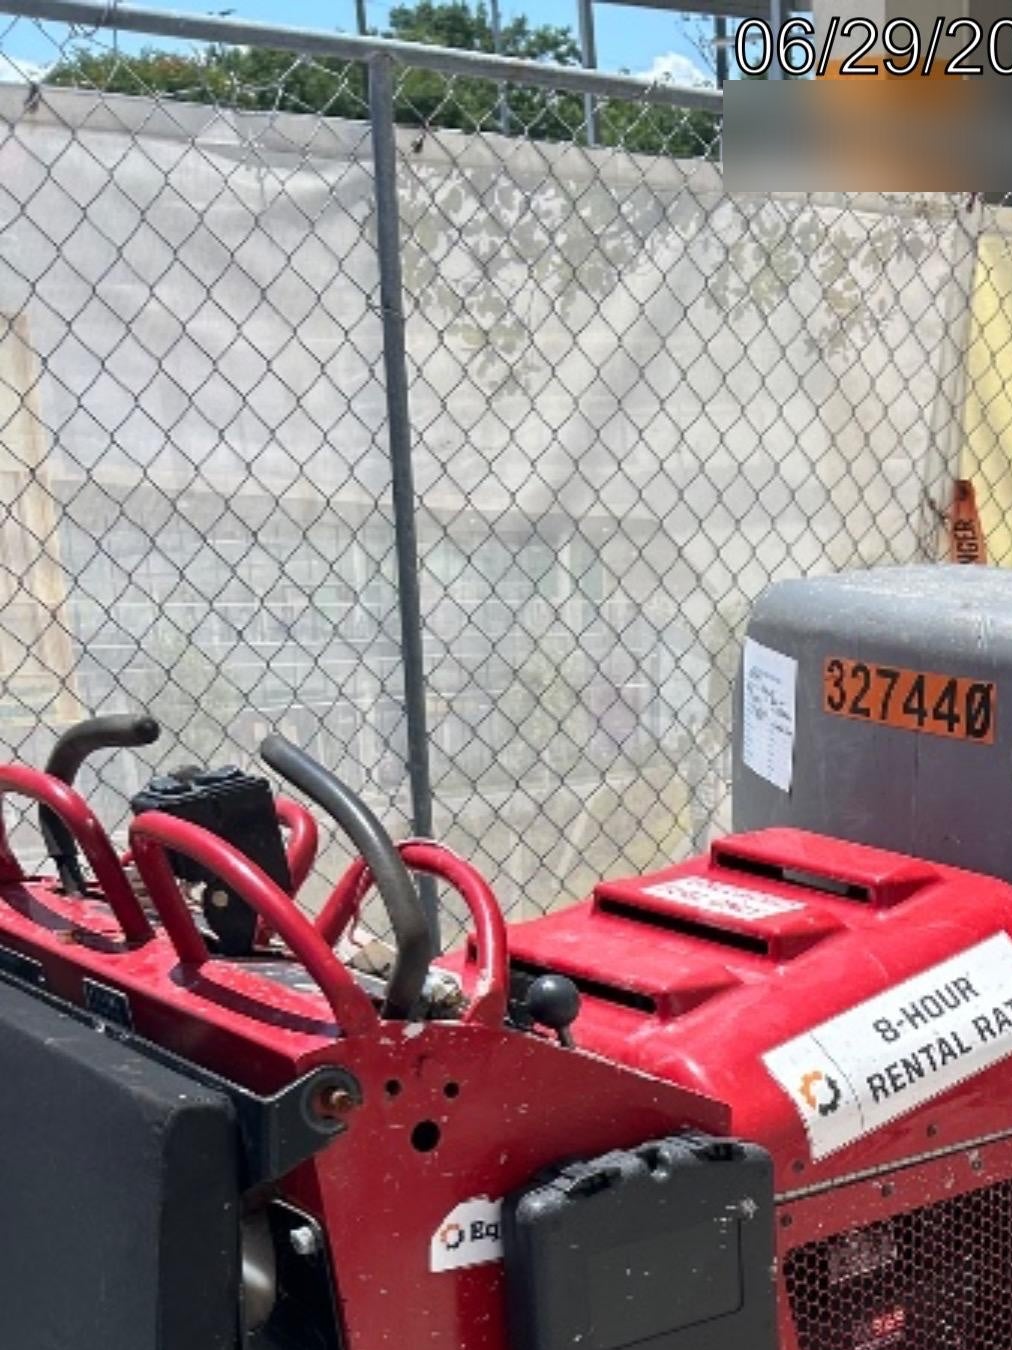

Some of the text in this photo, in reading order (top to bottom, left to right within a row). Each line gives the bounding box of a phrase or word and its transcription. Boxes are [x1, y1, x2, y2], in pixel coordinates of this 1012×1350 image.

[953, 519, 979, 565] NGER
[826, 658, 993, 739] 327440
[872, 975, 980, 1043] 8-HOUR
[866, 1031, 973, 1103] RENTAL
[470, 1220, 500, 1243] Eq
